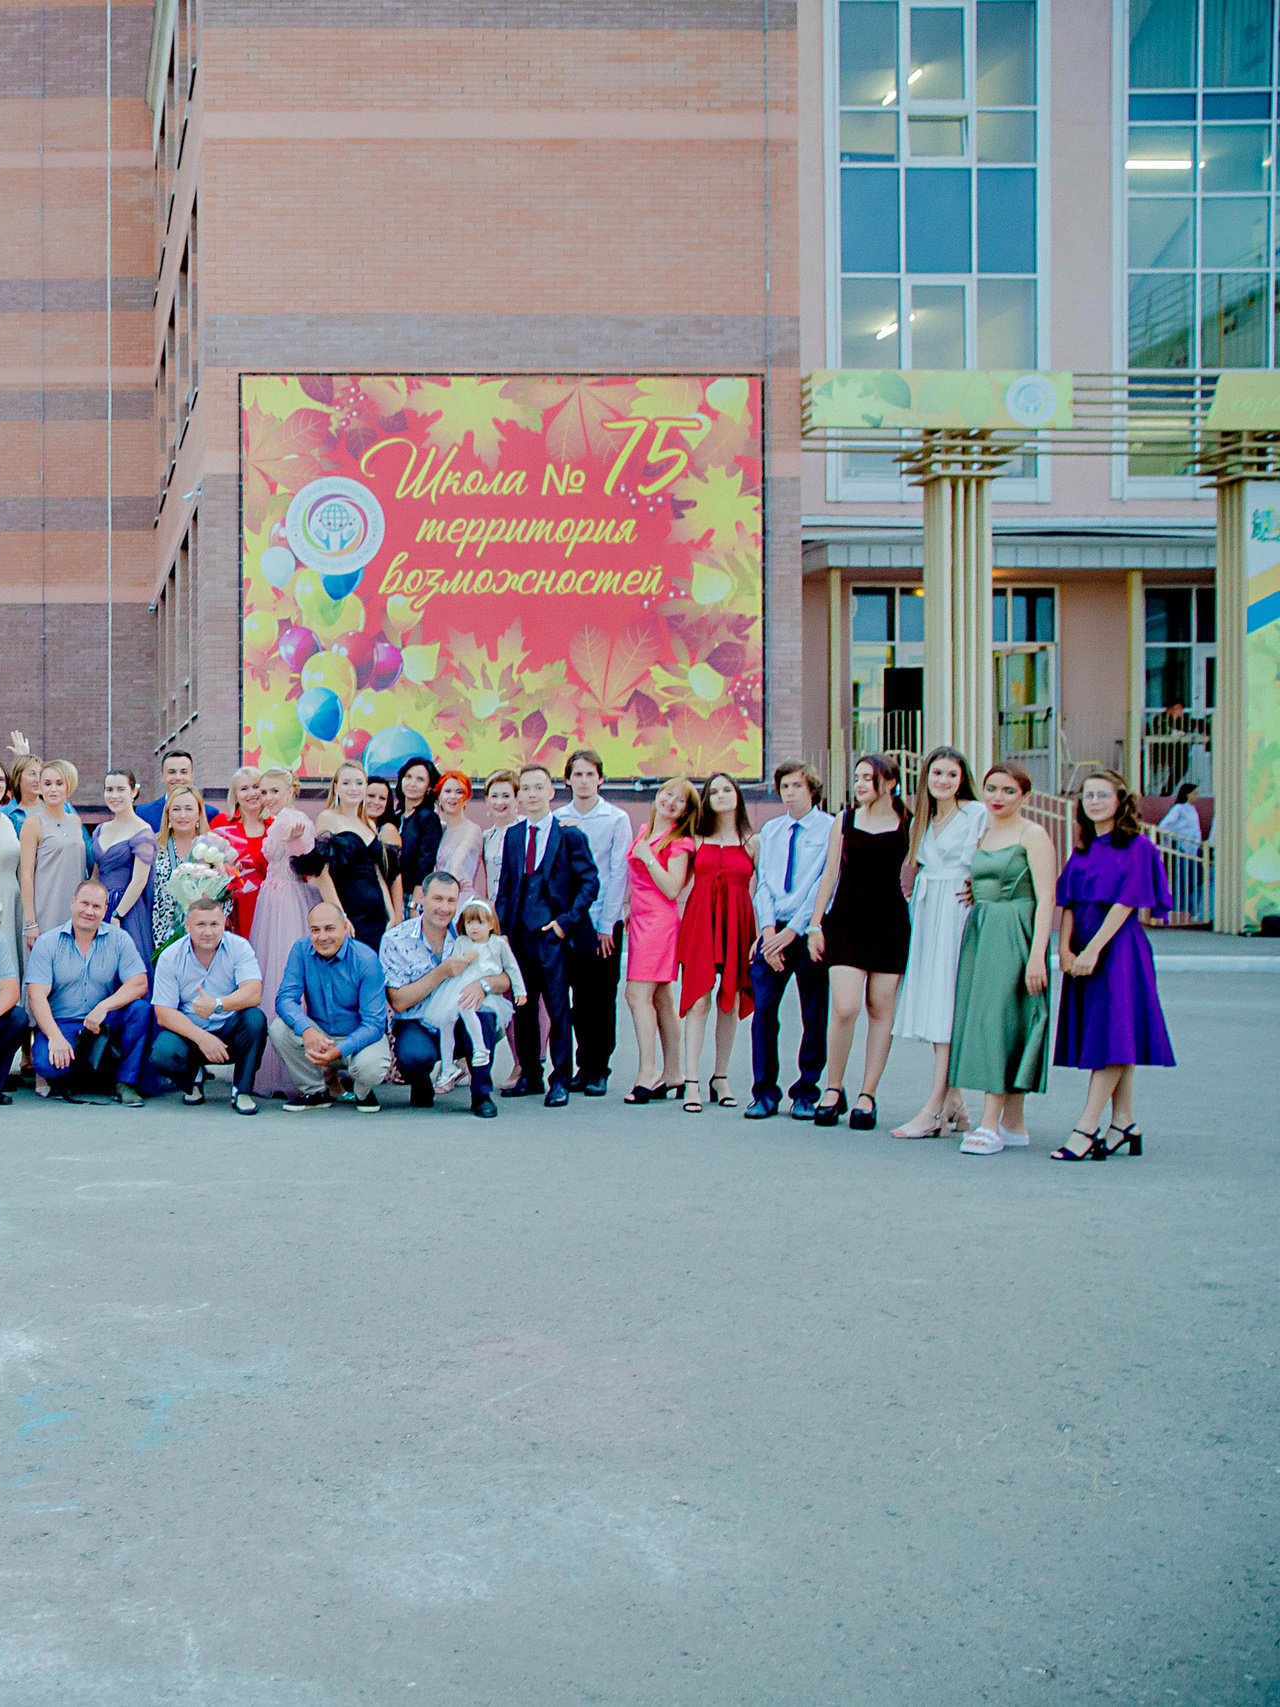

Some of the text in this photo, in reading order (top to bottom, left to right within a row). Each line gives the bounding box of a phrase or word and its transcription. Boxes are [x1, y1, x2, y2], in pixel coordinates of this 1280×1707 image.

[360, 419, 701, 505] Школа № 75
[415, 517, 639, 558] территория
[378, 551, 664, 610] возможностей
